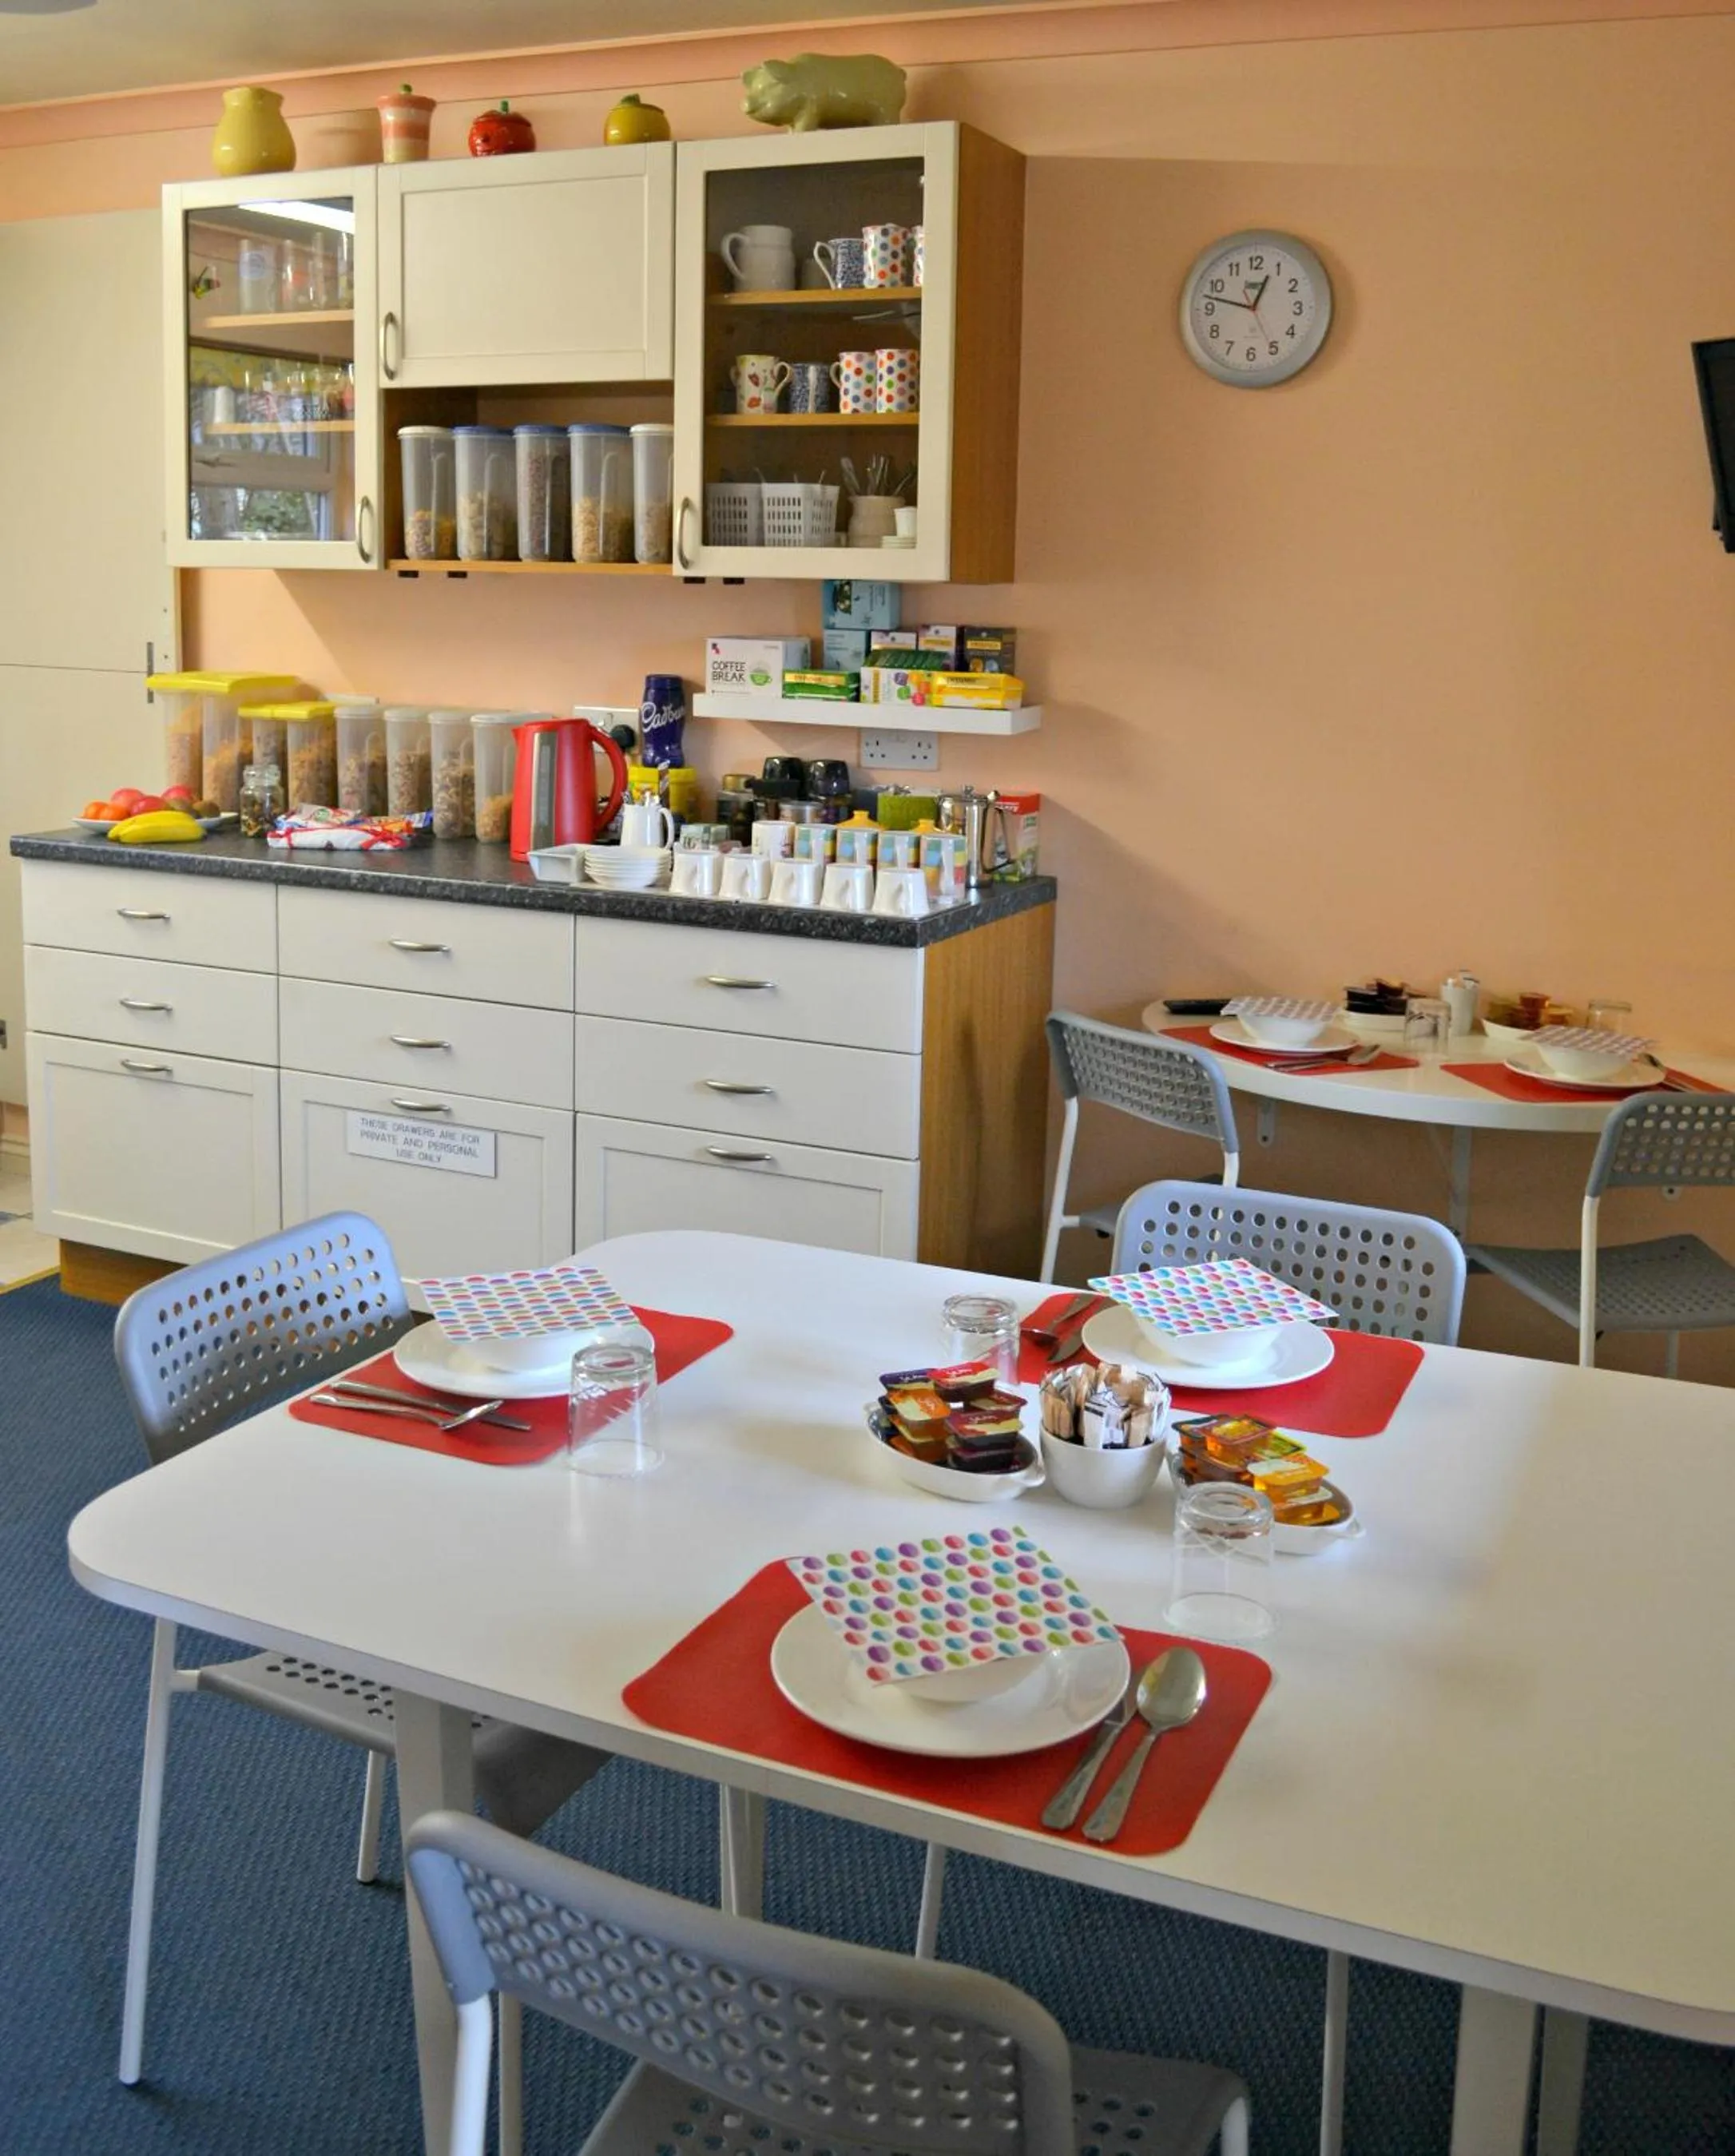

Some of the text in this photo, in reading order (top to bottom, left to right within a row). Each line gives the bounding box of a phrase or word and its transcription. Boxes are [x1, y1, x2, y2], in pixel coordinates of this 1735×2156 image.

[1229, 262, 1240, 276] 11
[1249, 256, 1264, 270] 12
[1275, 262, 1281, 276] 1
[1209, 279, 1225, 293] 10
[1288, 278, 1299, 293] 2
[1205, 302, 1215, 316] 9
[1292, 300, 1303, 316] 3
[1209, 324, 1220, 339] 8
[1285, 324, 1296, 339] 4
[1225, 340, 1235, 356] 7
[1246, 347, 1256, 362] 6
[1268, 340, 1278, 356] 5
[712, 661, 746, 673] COFFEE
[712, 671, 746, 683] BREAK
[641, 701, 685, 733] Cadbur
[360, 1118, 479, 1145] THESE DRAWERS ARE FOR
[360, 1130, 479, 1159] PRIVATE AND PERSONAL
[396, 1149, 442, 1163] USE ONLY
